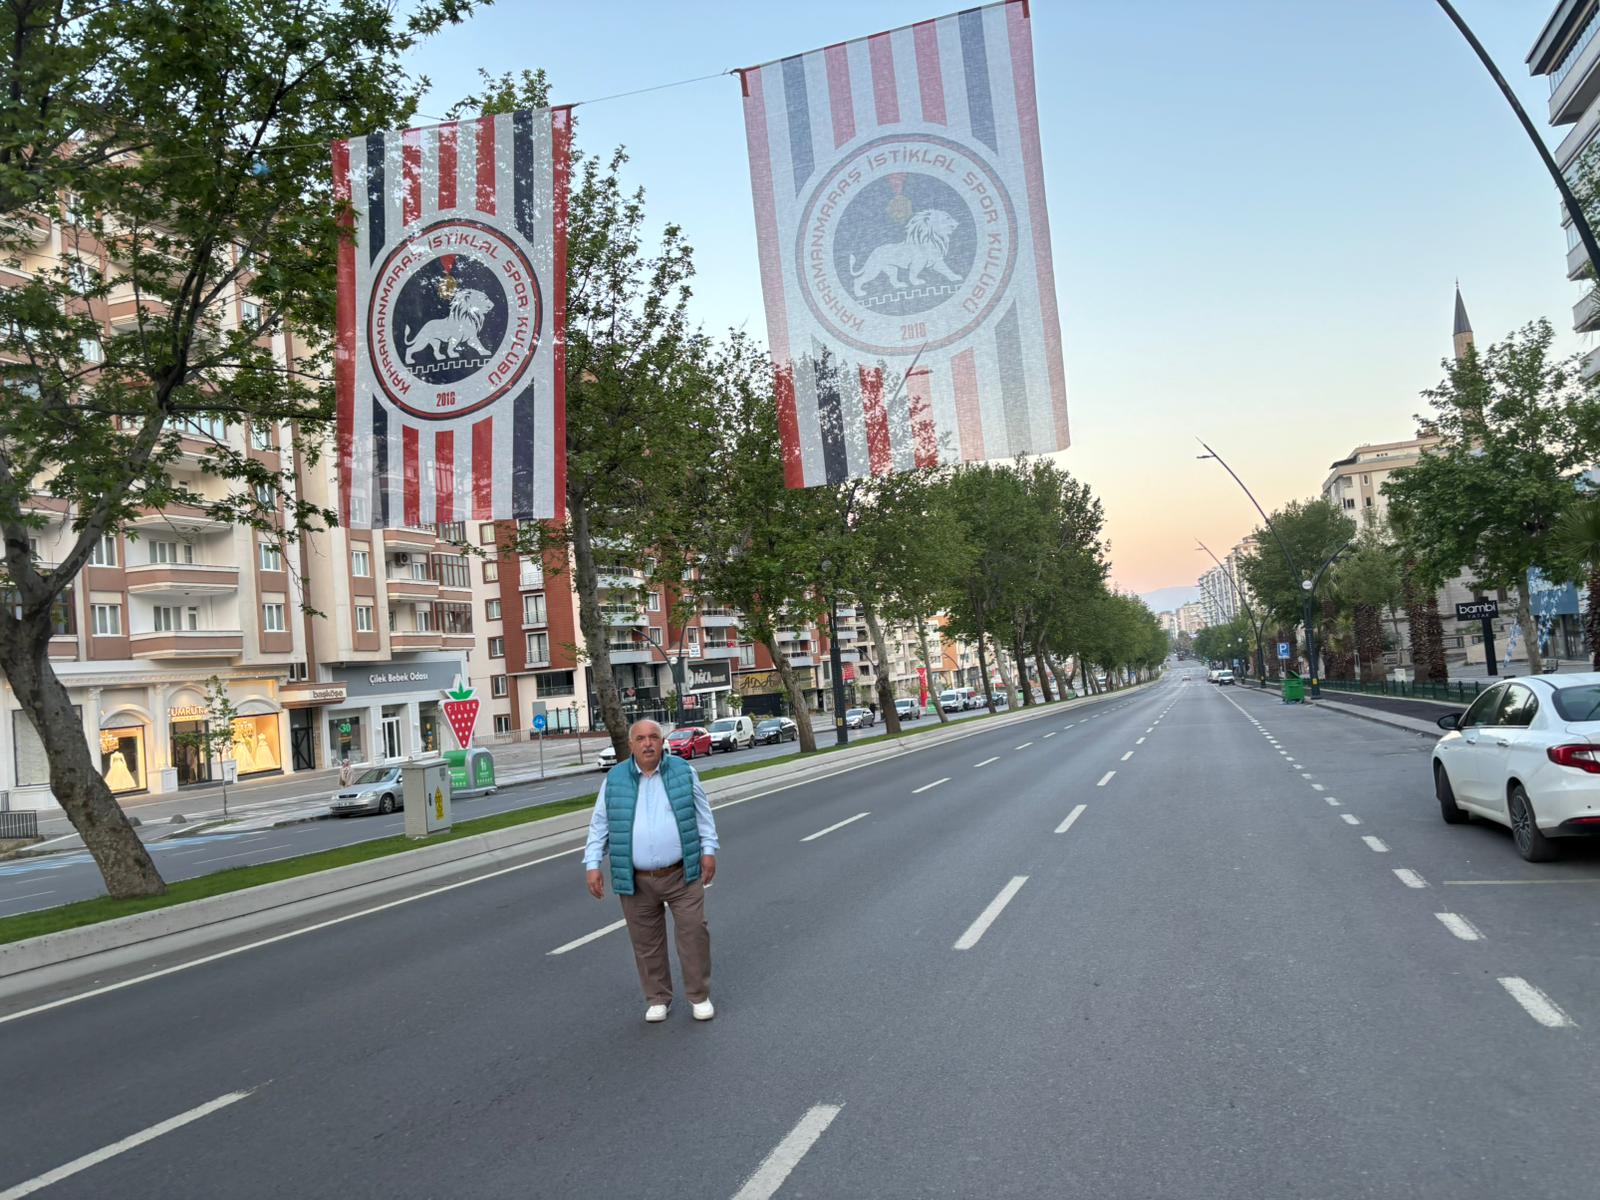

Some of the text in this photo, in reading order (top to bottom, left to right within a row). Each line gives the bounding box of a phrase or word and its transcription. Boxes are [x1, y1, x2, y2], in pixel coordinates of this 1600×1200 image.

[810, 145, 1001, 332] KAHRAMANMARAŞ İSTİKLAL SPOR KULÜBÜ
[502, 259, 529, 308] SPOR
[487, 316, 529, 387] KULÜBÜ
[436, 391, 456, 407] 2016
[1459, 602, 1496, 614] bambi
[369, 671, 429, 686] Çilek Bebek Odası
[447, 702, 477, 714] ÇİLEK
